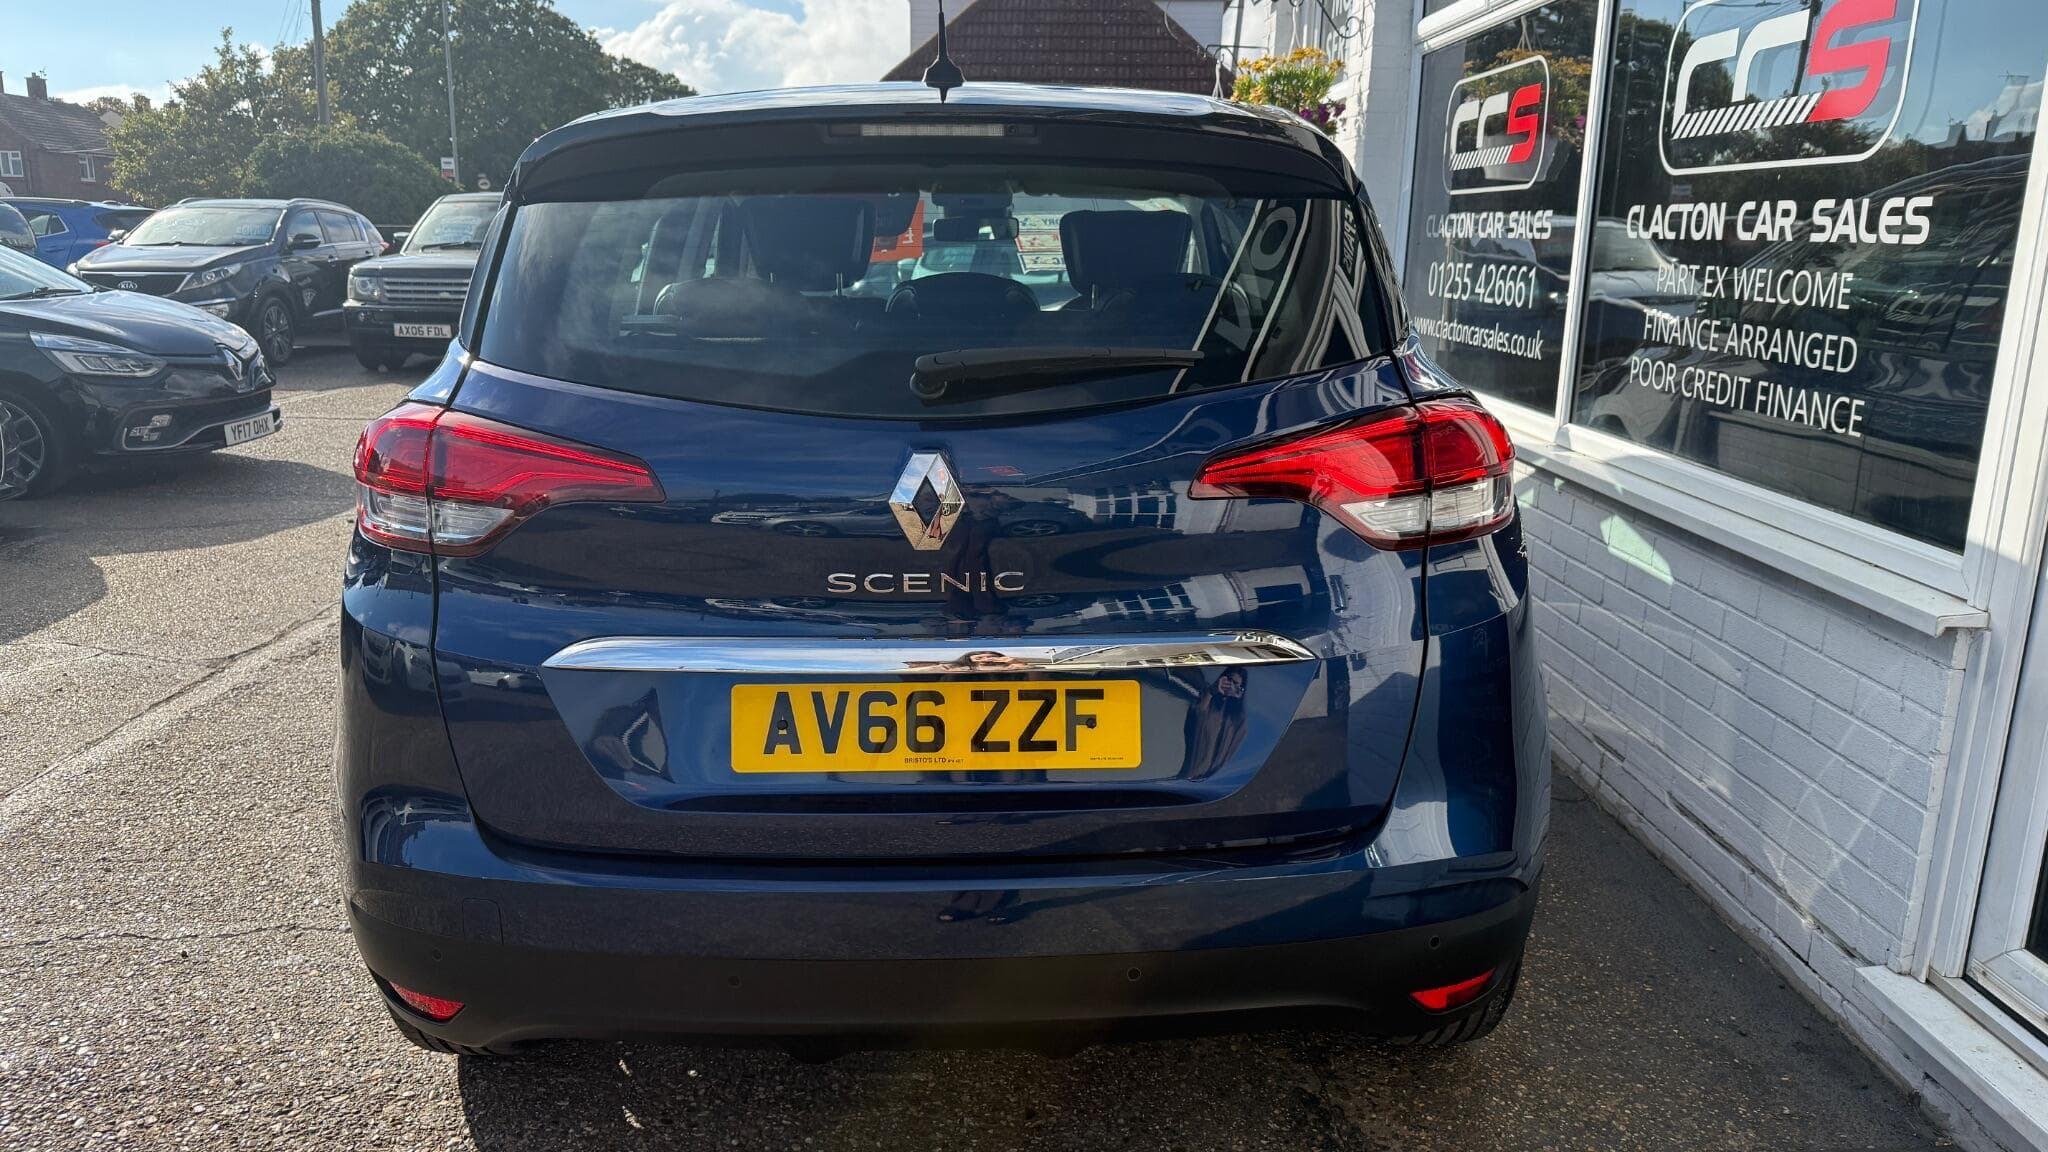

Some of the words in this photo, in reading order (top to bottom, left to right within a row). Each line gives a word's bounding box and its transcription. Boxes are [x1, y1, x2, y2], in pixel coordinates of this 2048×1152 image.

[1449, 83, 1541, 170] CCS
[1426, 212, 1475, 239] CLACTON
[1478, 211, 1504, 239] CAR
[1507, 209, 1553, 239] SALES
[1626, 202, 1726, 241] CLACTON
[1736, 199, 1797, 242] CAR
[1809, 196, 1933, 245] SALES
[1428, 261, 1474, 301] 01255
[1474, 263, 1537, 310] 426661
[1656, 263, 1700, 294] PART
[1702, 265, 1729, 299] EX
[1733, 268, 1854, 310] WELCOME
[399, 326, 425, 336] AX06
[427, 326, 447, 337] FDL
[1414, 315, 1544, 361] www.clactoncarsales.co.uk
[1643, 312, 1721, 352] FINANCE
[1724, 322, 1858, 374] ARRANGED
[1629, 356, 1677, 393] POOR
[1681, 366, 1751, 410] CREDIT
[1755, 379, 1866, 438] FINANCE
[231, 423, 251, 441] YF17
[827, 570, 1025, 594] SCENIC
[763, 690, 947, 755] AV66
[970, 689, 1105, 753] ZZF
